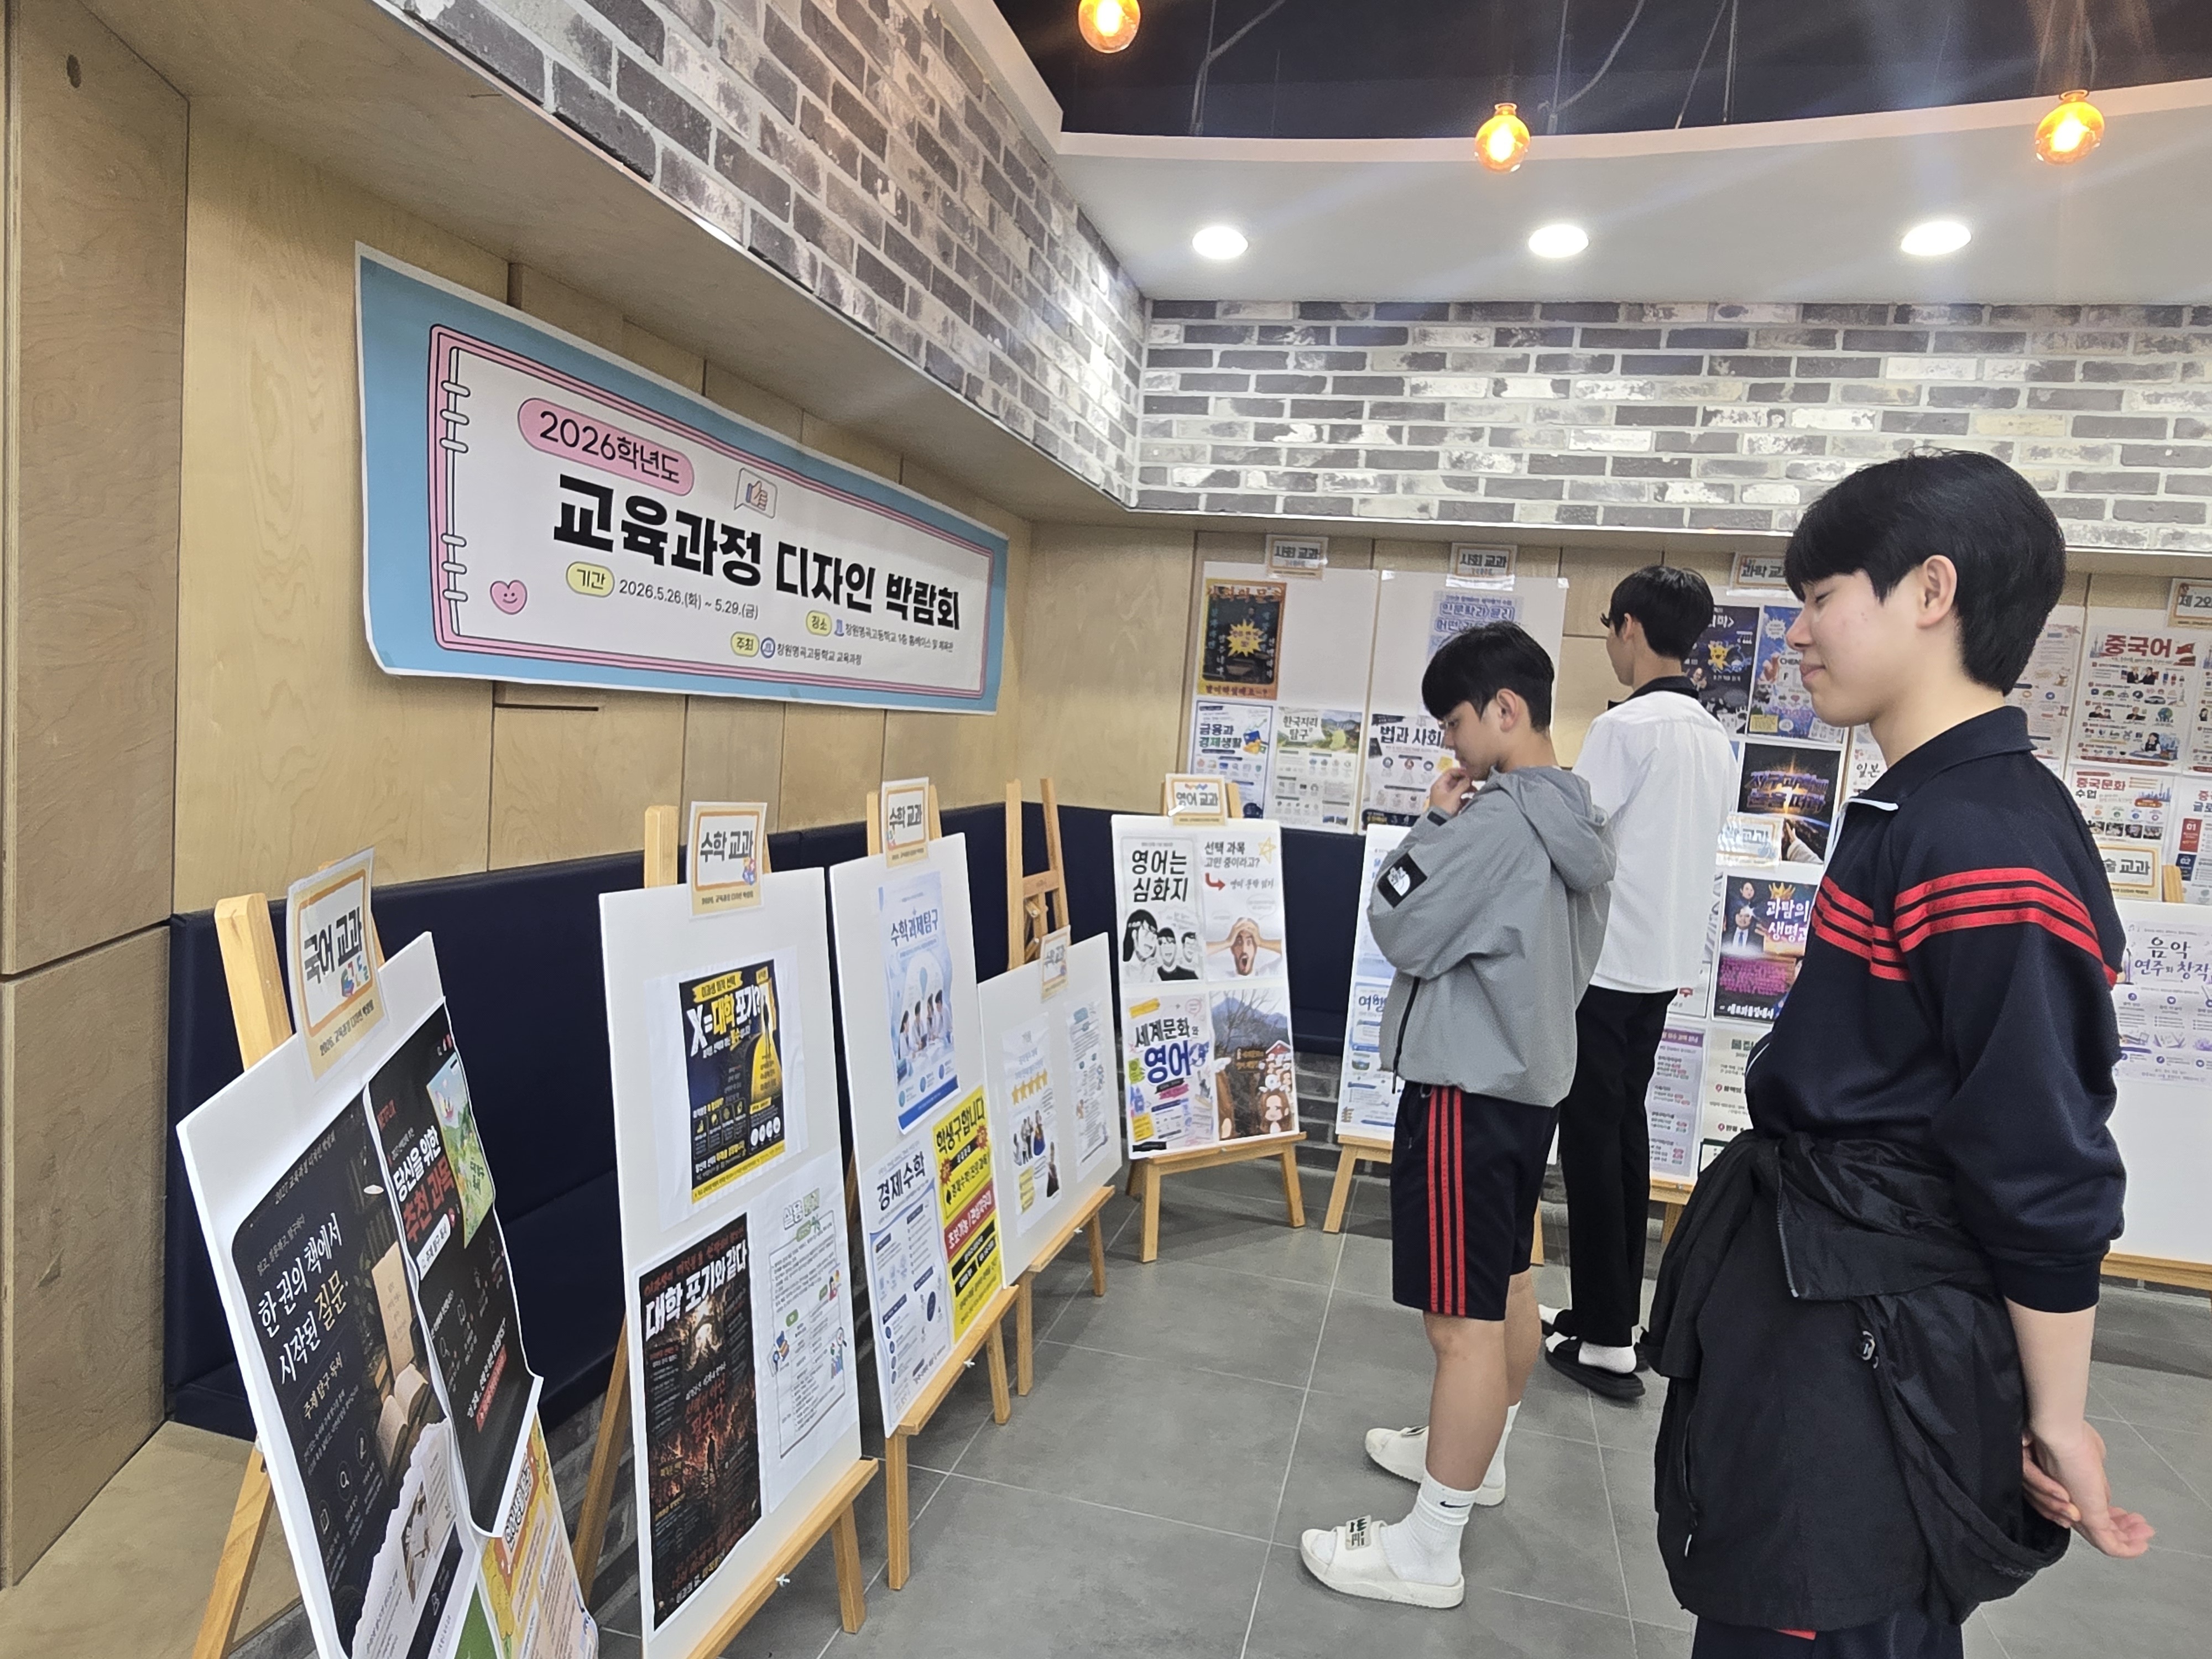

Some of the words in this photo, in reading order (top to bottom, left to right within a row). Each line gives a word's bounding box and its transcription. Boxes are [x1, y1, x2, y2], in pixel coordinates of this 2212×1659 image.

[540, 411, 679, 483] 2026학년도
[554, 473, 761, 586] 교육과정
[776, 541, 876, 613] 디자인
[886, 573, 959, 630] 박람회
[1274, 545, 1296, 559] 사회
[1298, 546, 1319, 560] 교과
[1459, 554, 1482, 566] 사회
[1484, 554, 1507, 567] 교과
[577, 568, 606, 590] 기간
[1741, 564, 1766, 578] 과학
[1768, 565, 1785, 578] 교
[619, 578, 702, 610] 2026.5.26.(화)
[812, 615, 827, 632] 장소
[2105, 634, 2172, 658] 중국어
[1199, 723, 1234, 735] 금융과
[1283, 716, 1318, 728] 한국지리
[1199, 737, 1242, 749] 경제생활
[1289, 728, 1309, 740] 탐구
[1380, 726, 1408, 744] 법과
[1412, 728, 1442, 747] 사회
[2075, 789, 2097, 799] 수업
[2077, 777, 2126, 791] 중국문화
[1176, 792, 1197, 806] 영어
[1199, 792, 1219, 806] 교과
[889, 806, 906, 834] 수학
[907, 804, 922, 827] 교과
[2187, 823, 2197, 831] 01
[700, 831, 727, 863] 수학
[729, 830, 754, 859] 교과
[1204, 841, 1224, 855] 선택
[1227, 841, 1245, 855] 과목
[1132, 849, 1187, 875] 영어는
[1204, 857, 1222, 869] 고민
[1224, 857, 1261, 869] 중이라고?
[2120, 859, 2151, 876] 교과
[1133, 877, 1188, 902] 심화지
[1767, 898, 1809, 922] 과탐의
[304, 924, 335, 984] 국어
[336, 906, 363, 967] 교과
[2147, 937, 2191, 959] 음악
[2177, 961, 2211, 982] 창작
[1144, 1040, 1191, 1084] 영어
[393, 1147, 425, 1202] 당신을
[420, 1125, 441, 1167] 위한
[877, 1151, 926, 1211] 경제수학
[403, 1185, 432, 1243] 추천
[427, 1155, 455, 1211] 과목
[258, 1291, 280, 1338] 한
[276, 1256, 307, 1316] 권의
[304, 1212, 342, 1274] 책에서
[645, 1282, 684, 1342] 대학
[726, 1239, 748, 1282] 같다
[279, 1311, 321, 1385] 시작된
[304, 1390, 319, 1420] 주제
[317, 1371, 330, 1400] 탐구
[330, 1352, 343, 1378] 독서
